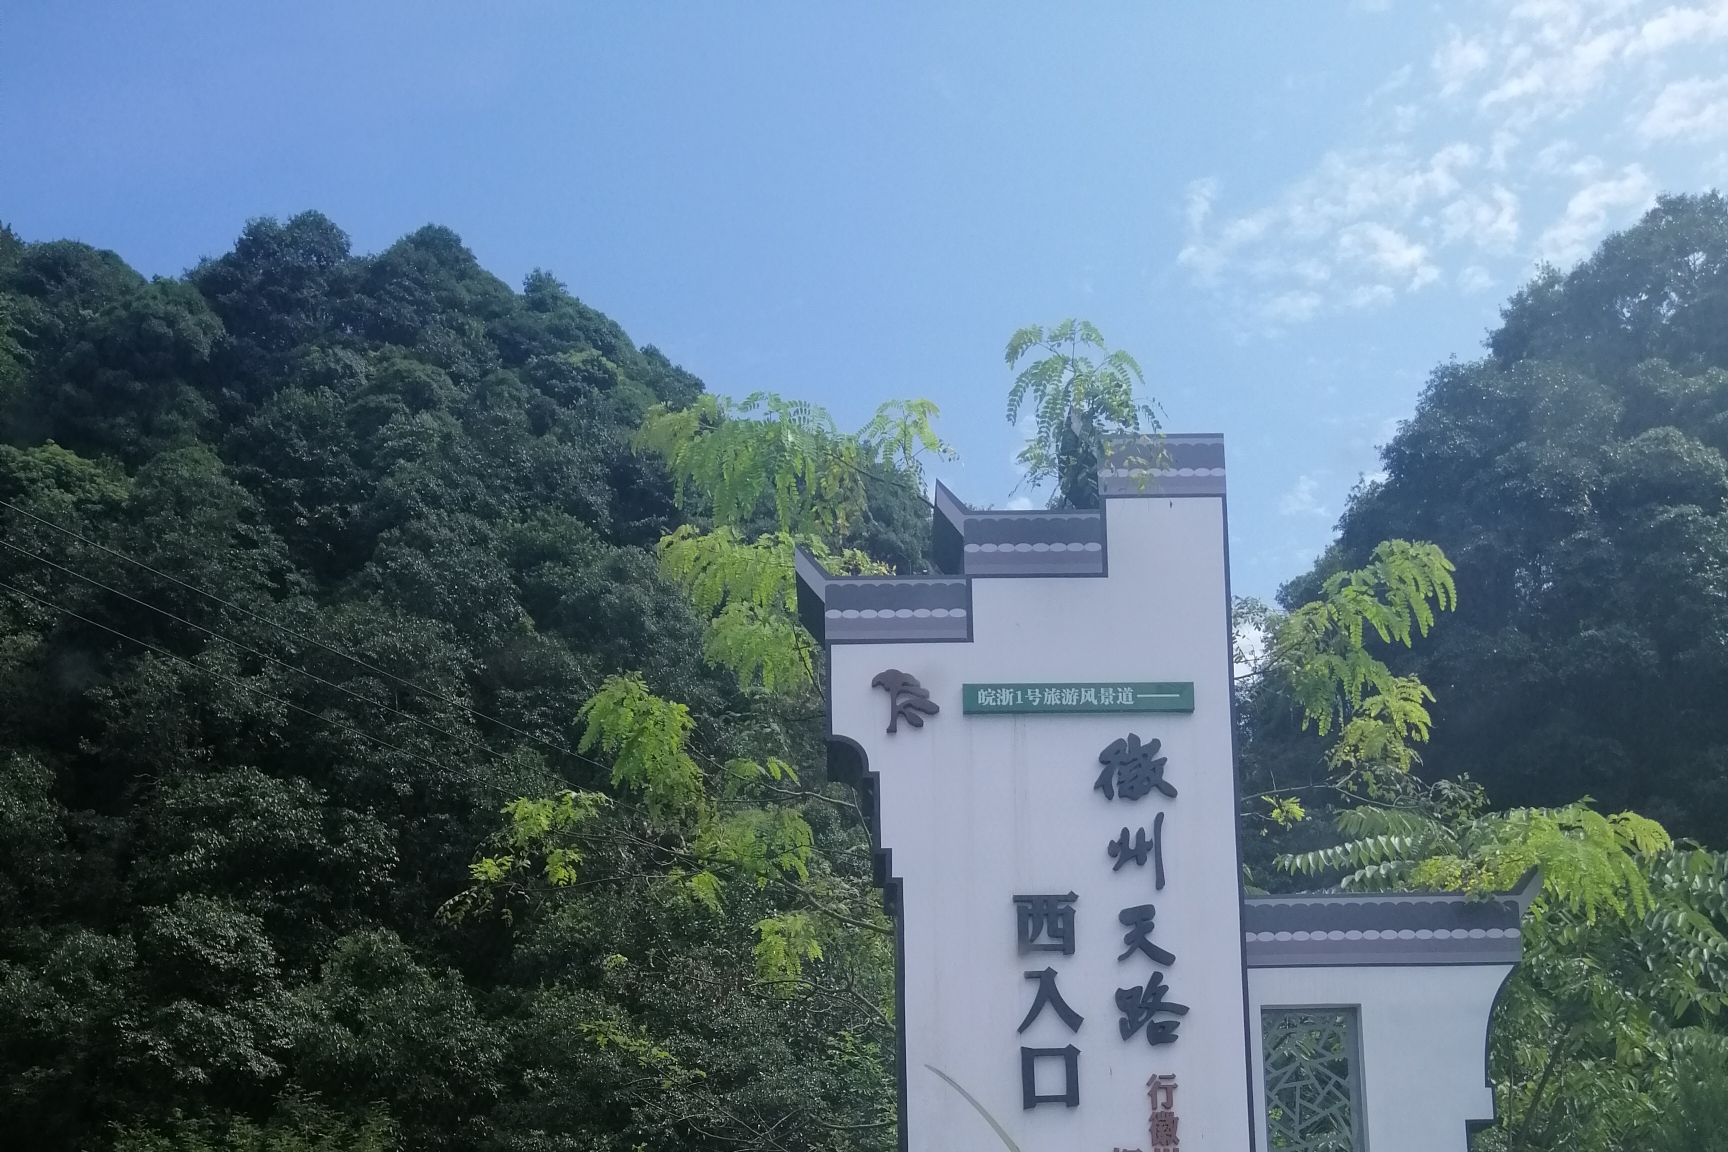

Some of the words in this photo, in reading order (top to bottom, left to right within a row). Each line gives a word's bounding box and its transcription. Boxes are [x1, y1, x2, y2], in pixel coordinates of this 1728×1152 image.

[1012, 890, 1084, 1110] 西入口
[1094, 733, 1190, 1046] 徽州天路
